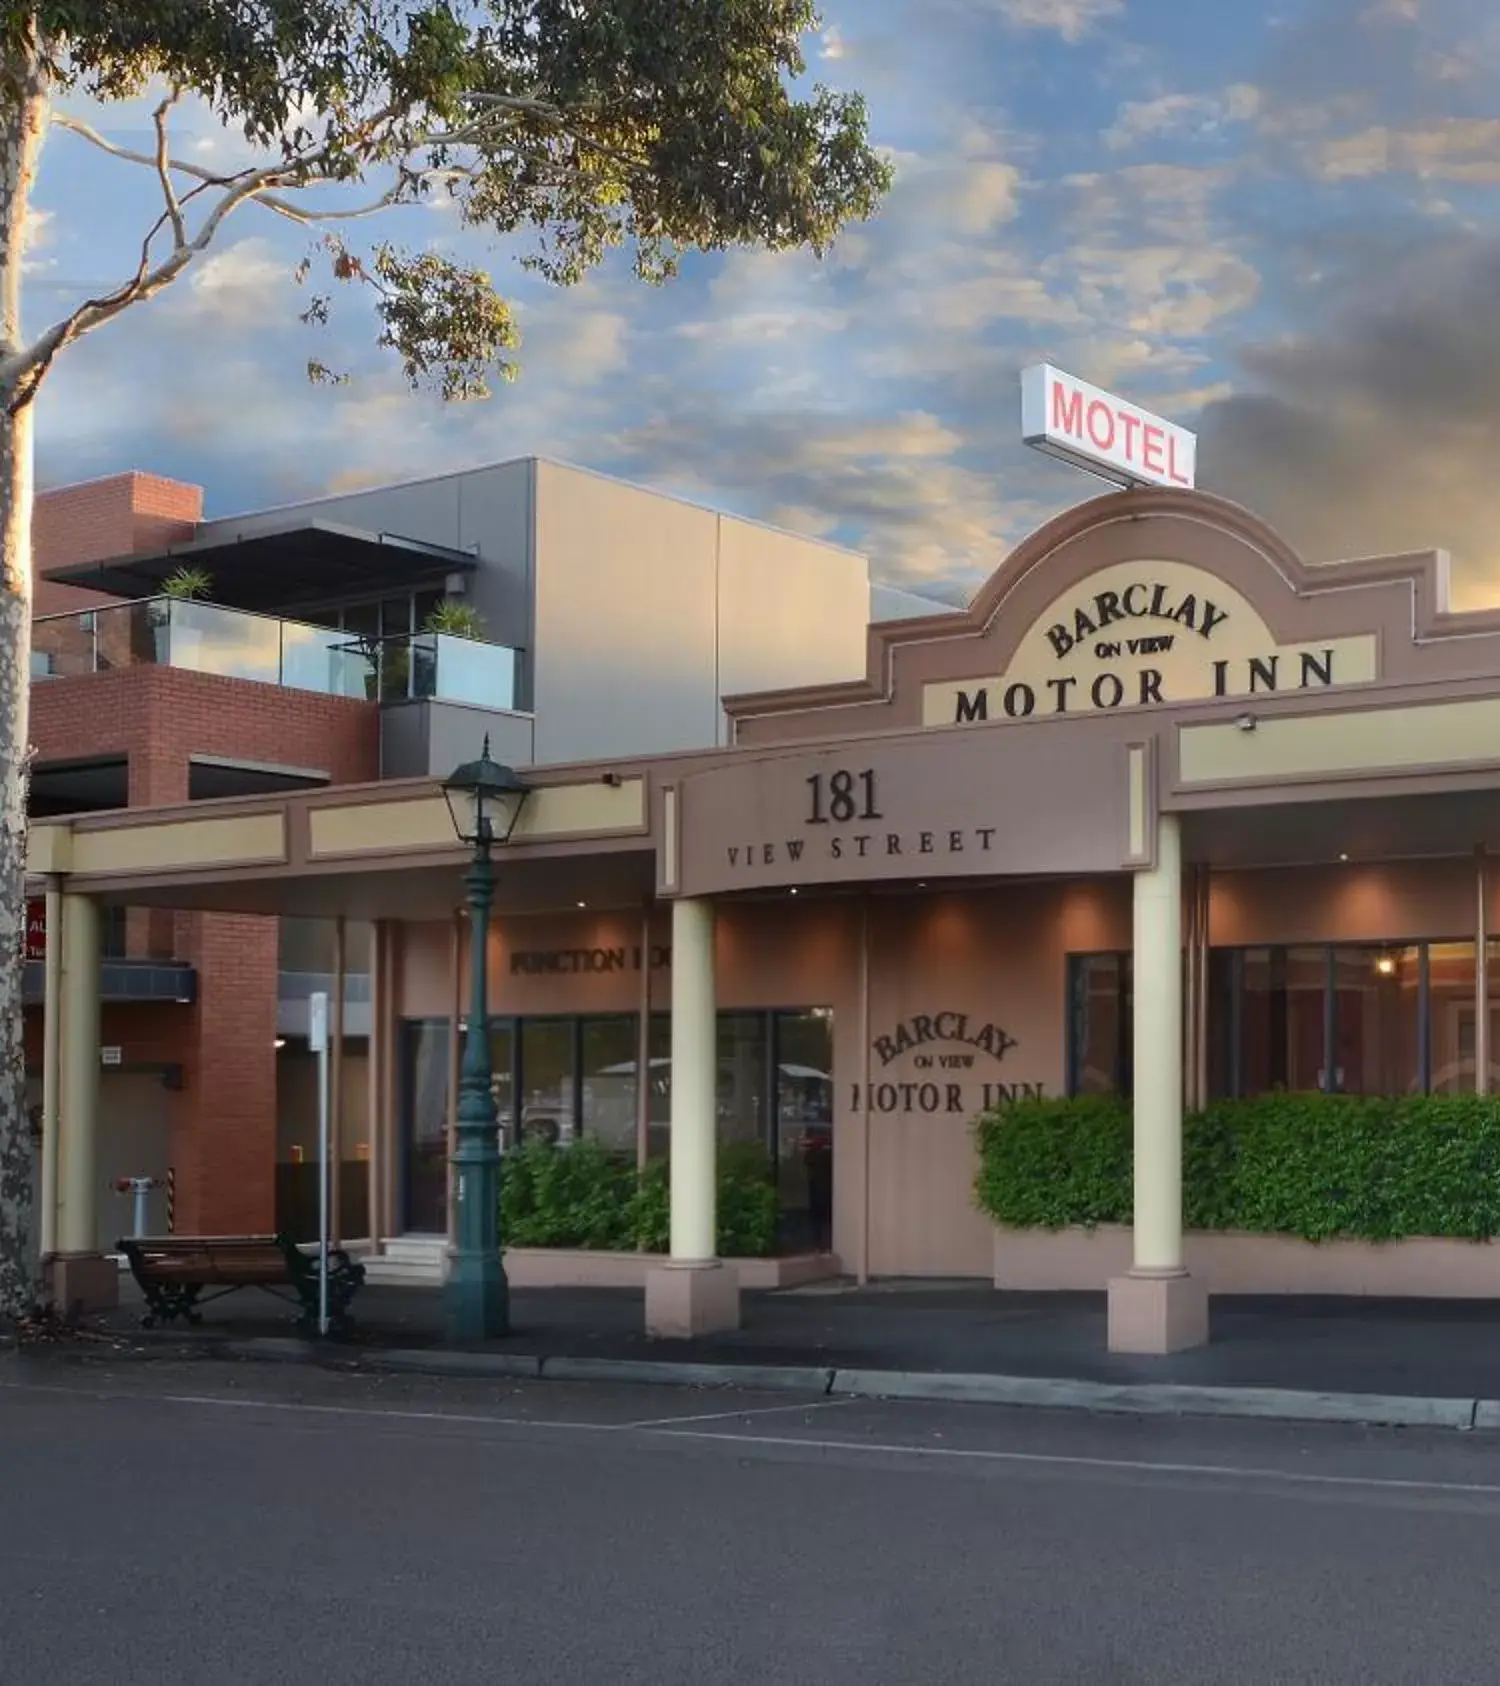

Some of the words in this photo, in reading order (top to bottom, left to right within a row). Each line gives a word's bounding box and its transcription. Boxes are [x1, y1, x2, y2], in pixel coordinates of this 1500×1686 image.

[1053, 380, 1188, 484] MOTEL
[1045, 583, 1228, 659] BARCLAY
[1094, 642, 1121, 659] ON
[1126, 634, 1175, 655] VIEW
[955, 668, 1164, 723] MOTOR
[1212, 649, 1334, 696] INN
[804, 769, 884, 824] 181
[727, 840, 804, 867] VIEW
[830, 828, 996, 859] STREET
[873, 1011, 1019, 1067] BARCLAY
[914, 1055, 933, 1068] ON
[939, 1055, 975, 1069] VIEW
